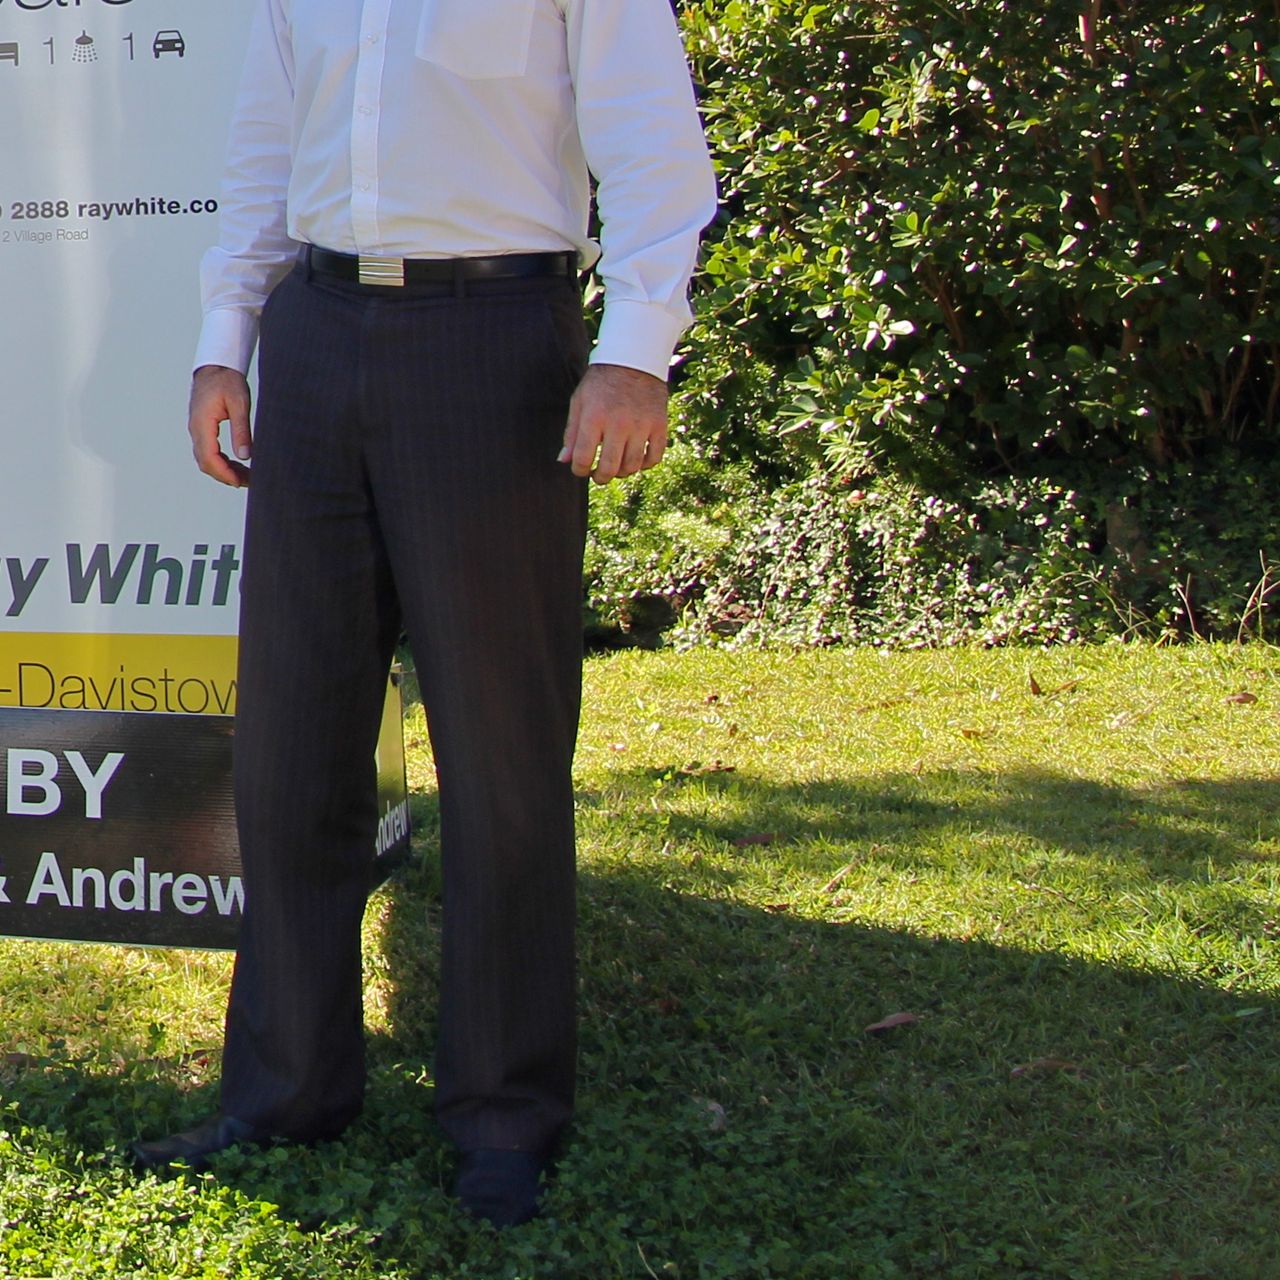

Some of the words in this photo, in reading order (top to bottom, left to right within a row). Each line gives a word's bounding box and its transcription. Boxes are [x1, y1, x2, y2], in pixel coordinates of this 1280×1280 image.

[42, 36, 54, 65] 1
[122, 31, 134, 61] 1
[11, 200, 70, 220] 2888
[77, 197, 219, 220] raywhite.co
[2, 230, 11, 242] 2
[13, 228, 53, 244] Village
[56, 228, 89, 241] Road
[65, 542, 242, 607] Whit
[5, 747, 126, 819] BY
[376, 800, 408, 857] ndrew
